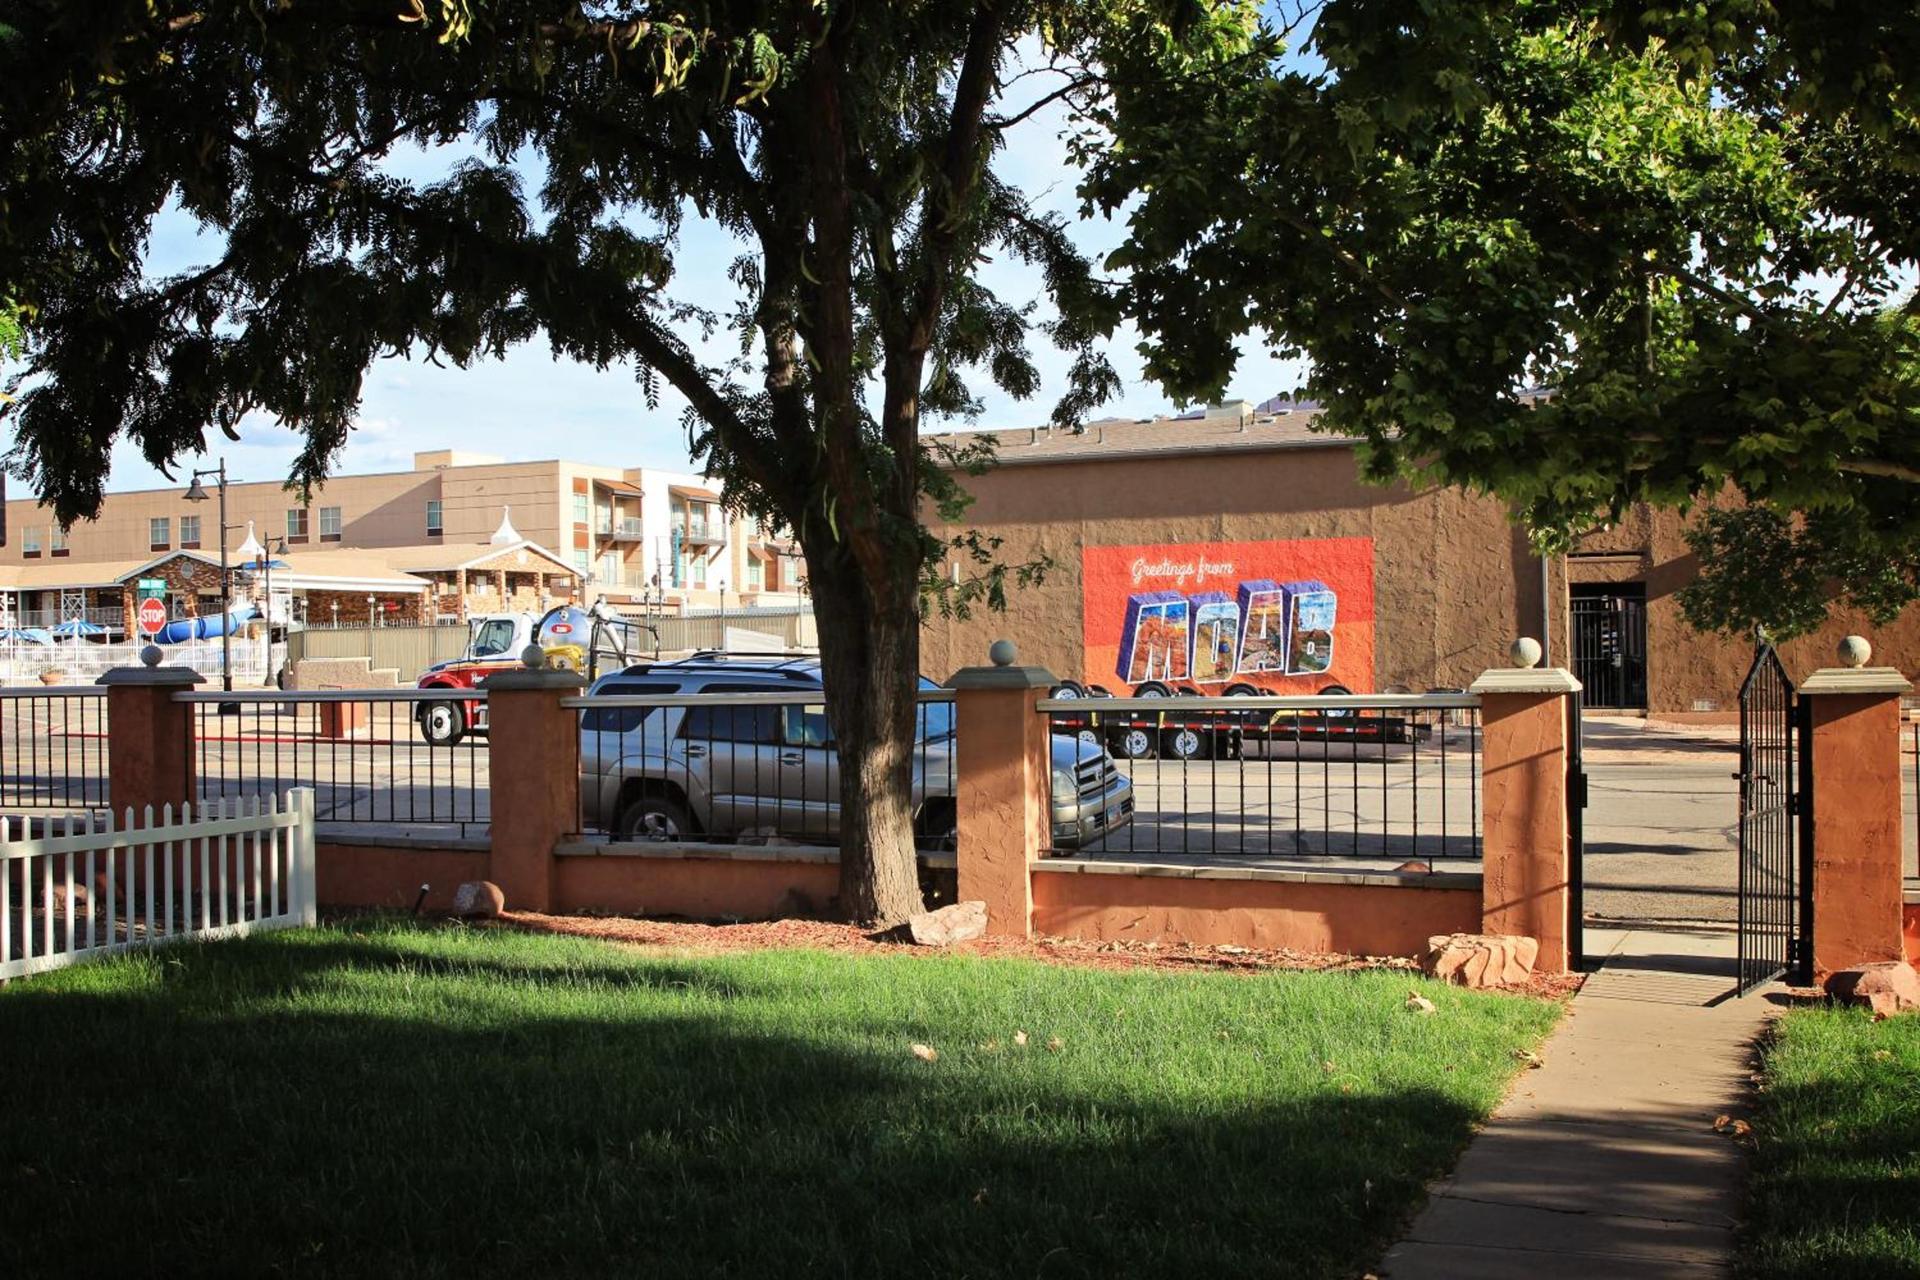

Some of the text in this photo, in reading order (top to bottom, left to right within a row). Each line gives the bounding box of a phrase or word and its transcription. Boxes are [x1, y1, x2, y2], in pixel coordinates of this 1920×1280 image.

[1132, 555, 1234, 584] Greetings from
[142, 609, 165, 623] STOP
[1116, 579, 1337, 684] MOAB
